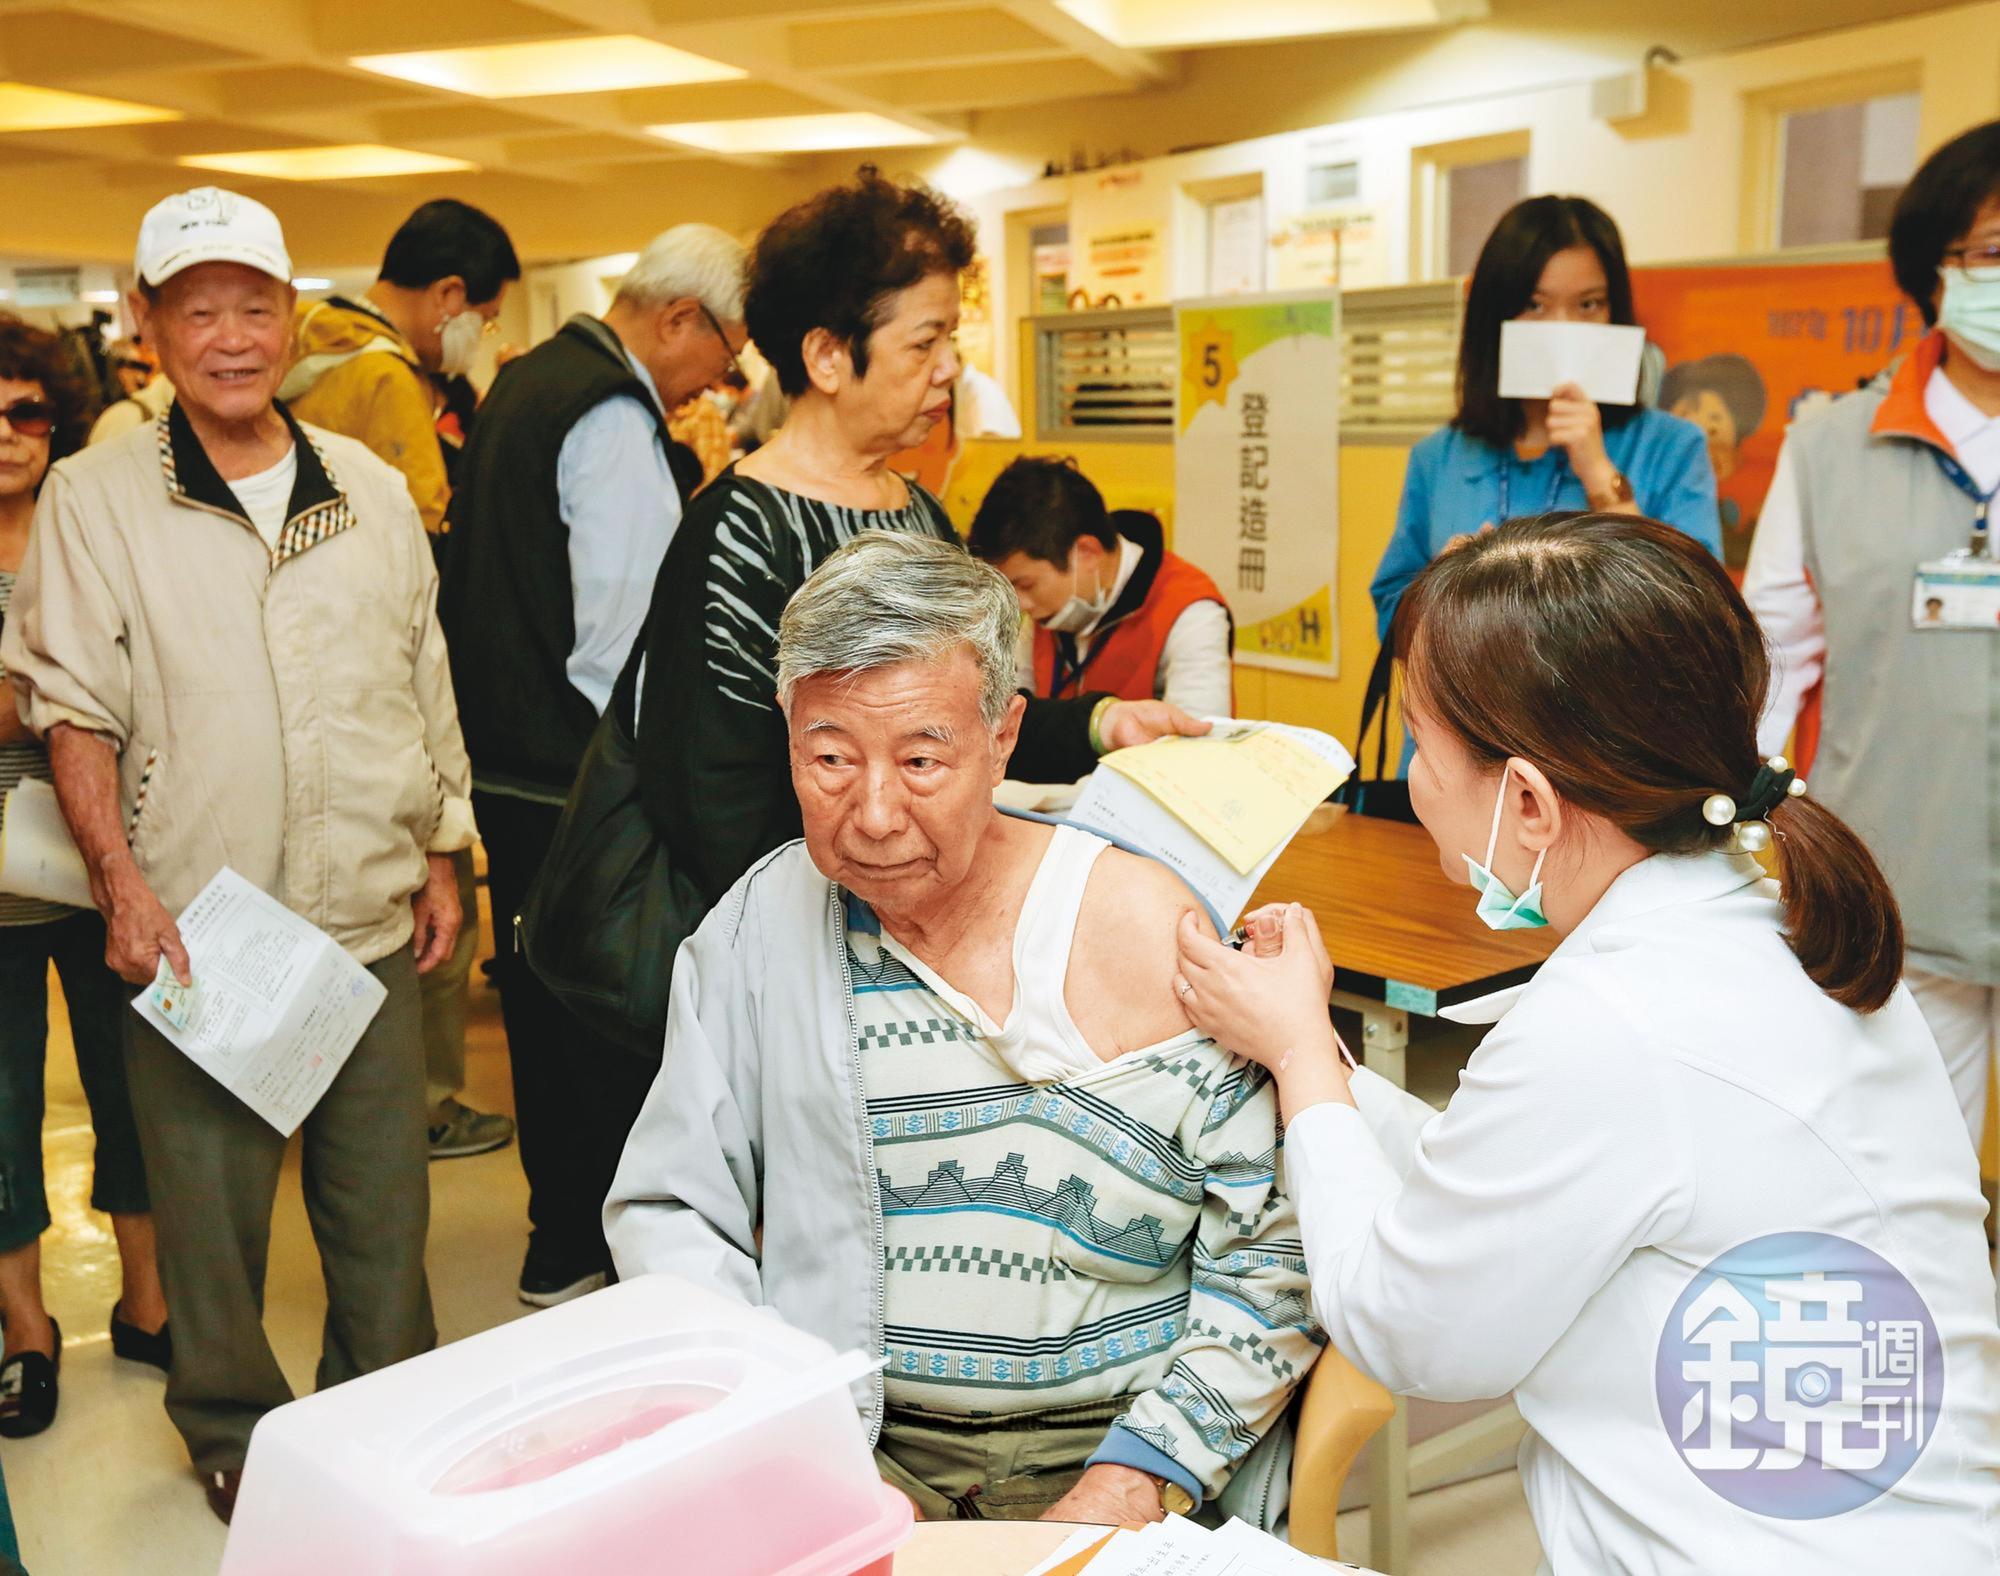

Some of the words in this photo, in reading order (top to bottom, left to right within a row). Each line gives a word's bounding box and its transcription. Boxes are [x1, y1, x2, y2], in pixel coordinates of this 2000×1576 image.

[1203, 343, 1222, 389] 5
[1238, 393, 1269, 593] 登記造冊
